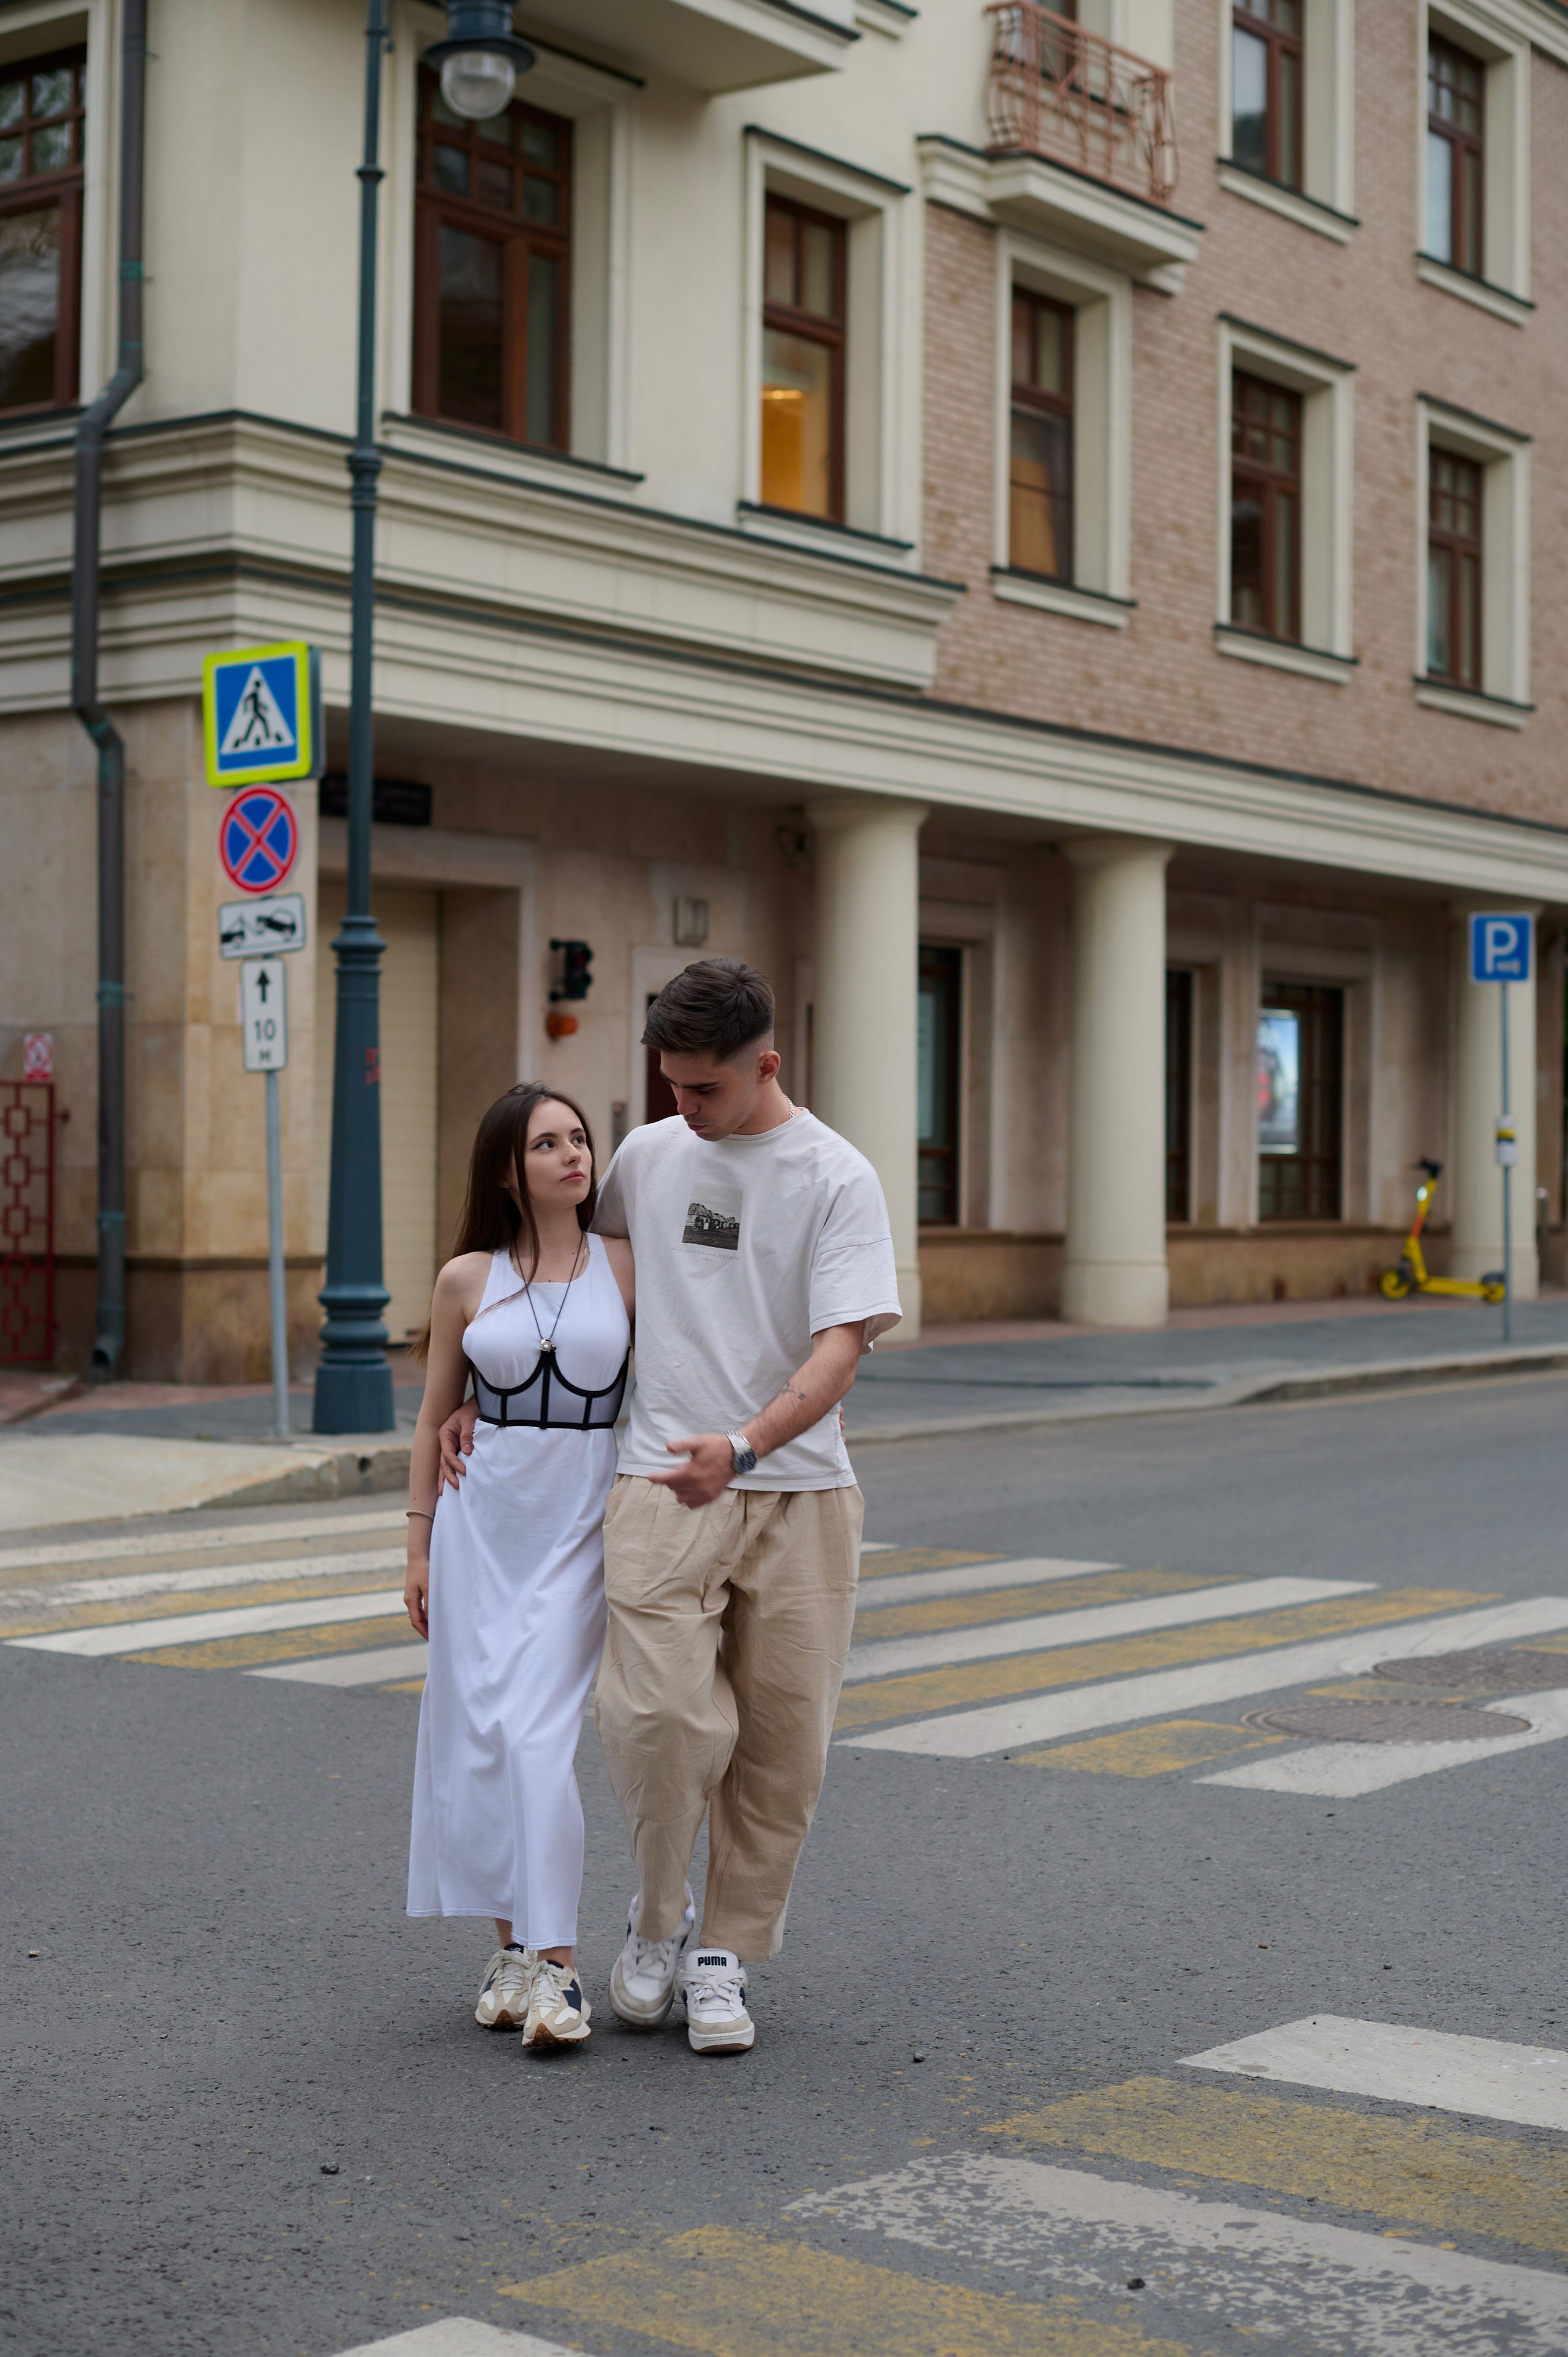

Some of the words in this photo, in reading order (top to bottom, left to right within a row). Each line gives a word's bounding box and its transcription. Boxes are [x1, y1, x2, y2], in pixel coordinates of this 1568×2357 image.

[1485, 921, 1518, 973] P
[255, 1019, 276, 1041] 10
[698, 1956, 726, 1967] PUMA
